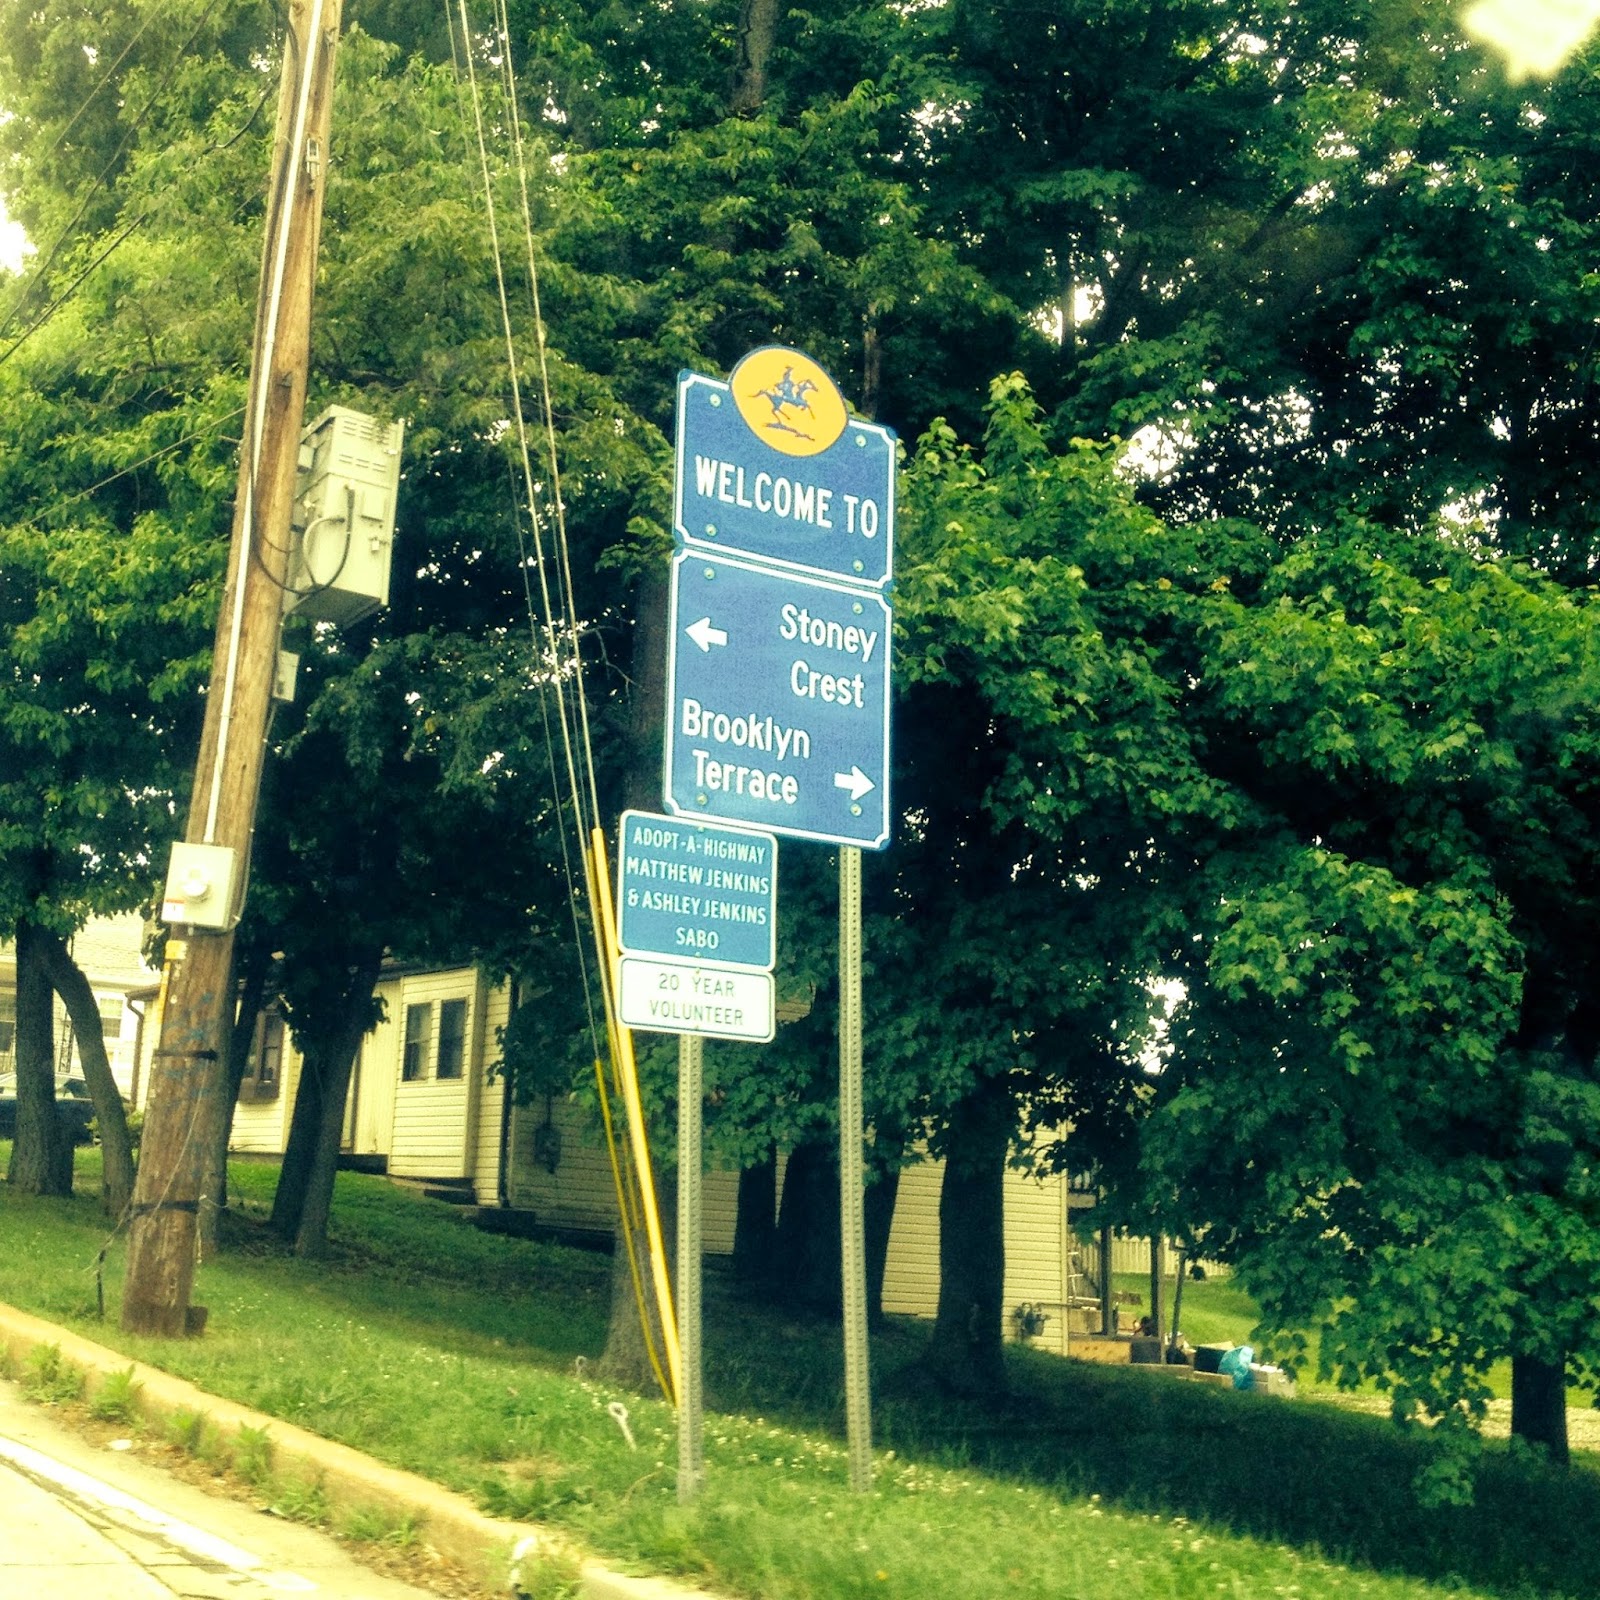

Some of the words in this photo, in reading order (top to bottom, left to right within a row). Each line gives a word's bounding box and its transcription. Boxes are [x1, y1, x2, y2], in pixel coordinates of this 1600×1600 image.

[695, 455, 833, 529] WELCOME
[843, 494, 879, 539] TO
[779, 603, 878, 663] Stoney
[790, 660, 865, 709] Crest
[682, 698, 812, 761] Brooklyn
[692, 749, 799, 805] Terrace
[626, 856, 704, 886] MATTHEW
[705, 869, 770, 895] JENKINS
[627, 888, 639, 907] &
[641, 890, 701, 916] ASHLEY
[702, 899, 767, 925] JENKINS
[675, 926, 720, 949] SABO
[658, 972, 680, 991] 20
[691, 976, 736, 997] YEAR
[649, 999, 745, 1026] VOLUNTEER
